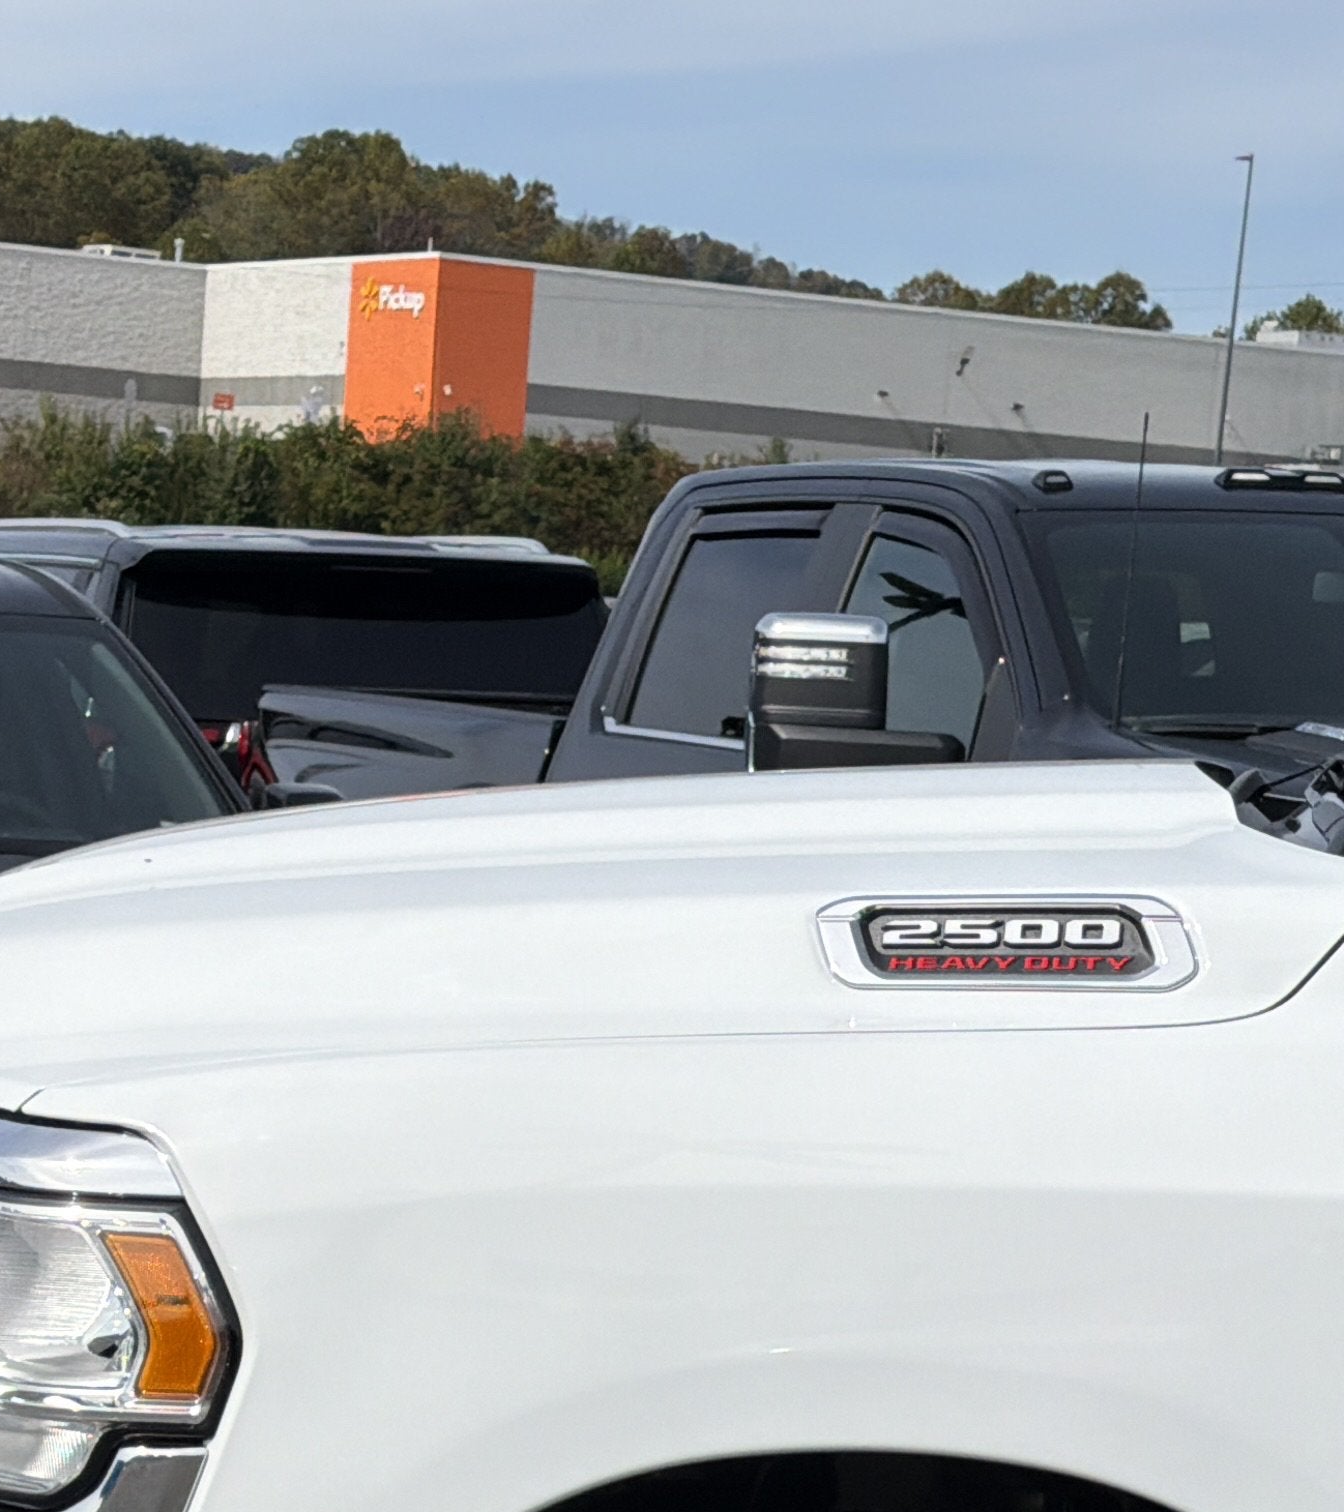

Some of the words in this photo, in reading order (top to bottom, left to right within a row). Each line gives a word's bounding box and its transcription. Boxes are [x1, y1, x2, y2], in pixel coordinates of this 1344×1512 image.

[378, 284, 425, 319] Pickup
[881, 918, 1124, 949] 2500
[887, 955, 1020, 972] HEAVY
[1022, 955, 1134, 972] DUTY
